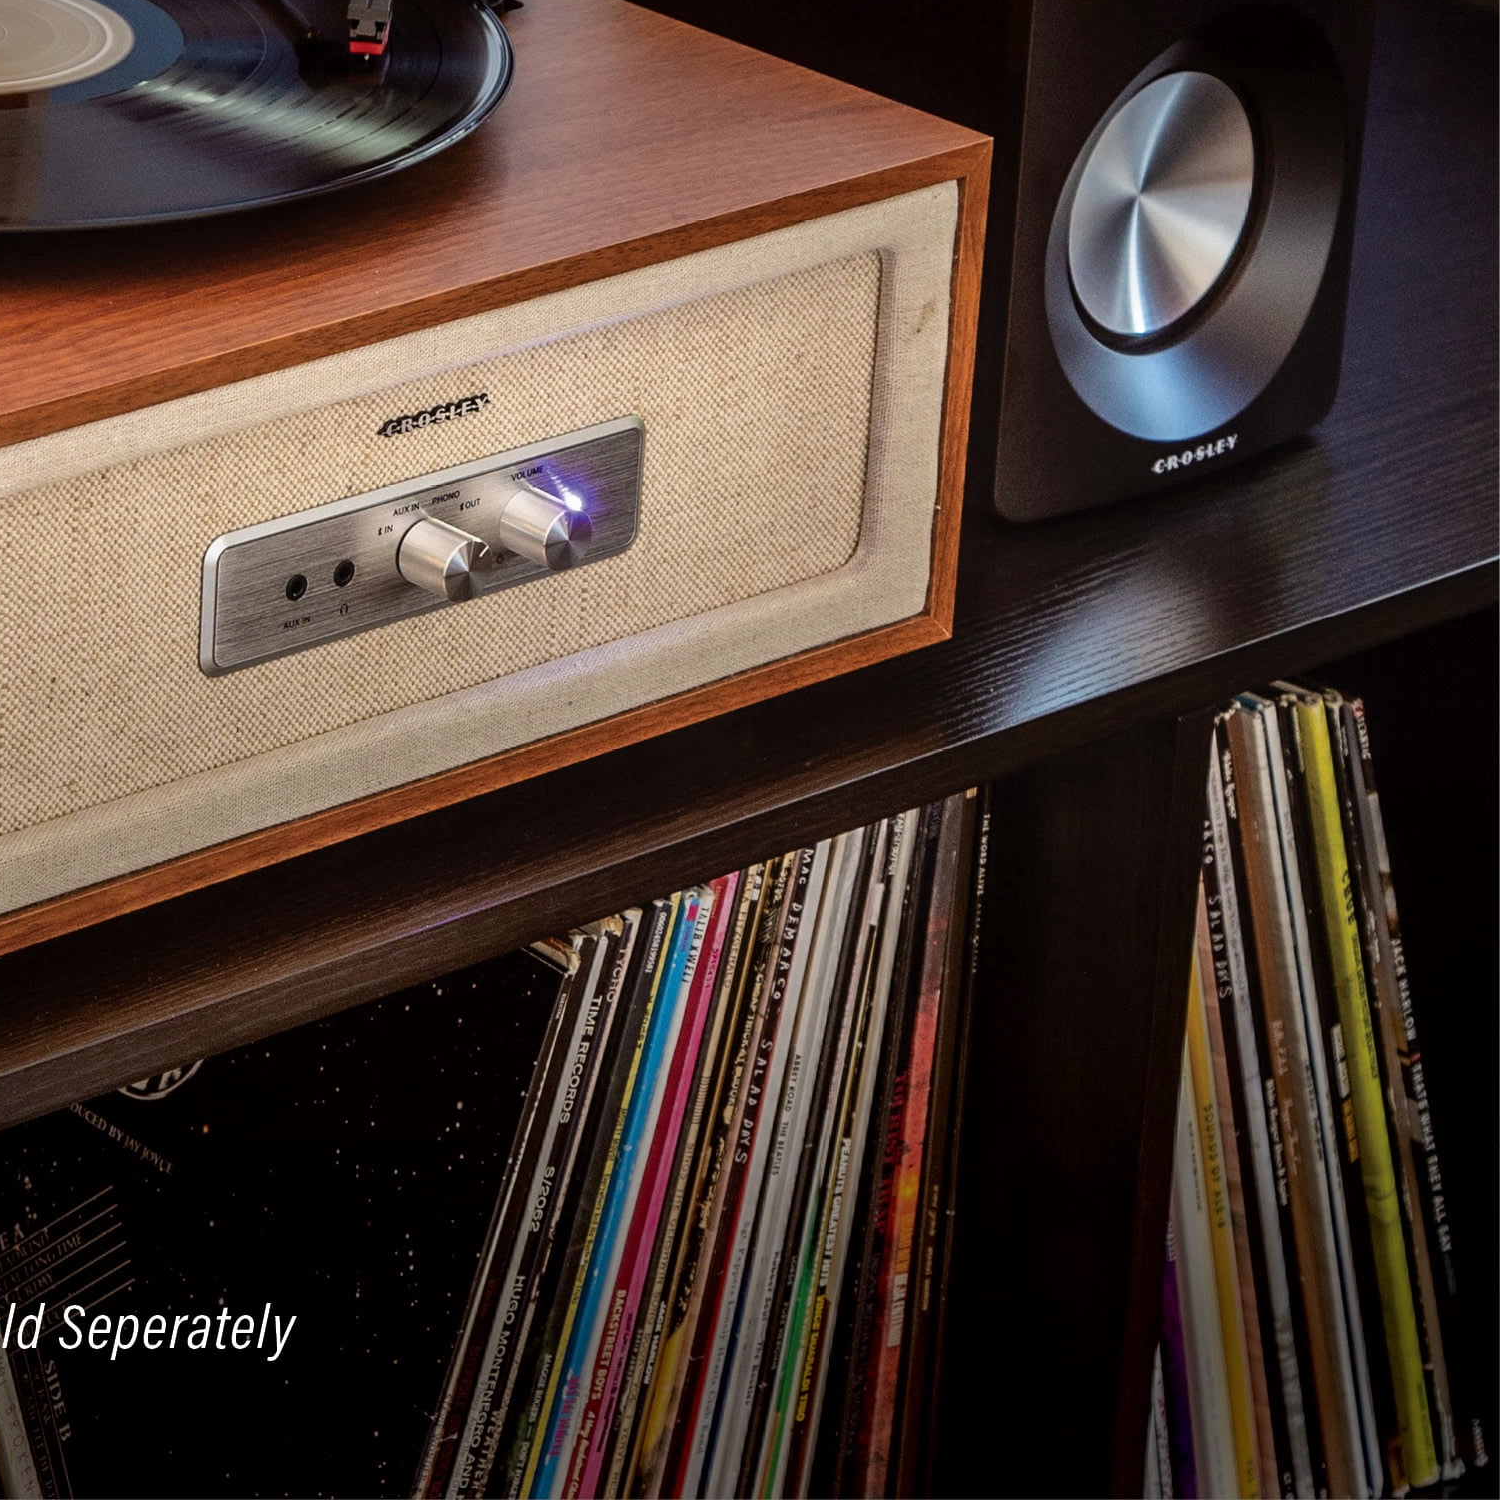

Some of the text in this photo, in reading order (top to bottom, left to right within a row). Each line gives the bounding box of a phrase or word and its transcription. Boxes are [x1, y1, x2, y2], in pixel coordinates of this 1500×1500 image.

[379, 394, 489, 437] CROSLEY
[511, 465, 545, 482] VOLUME
[1151, 433, 1238, 474] CROSLEY
[393, 502, 421, 517] AUX IN
[432, 490, 460, 506] PHONO
[464, 497, 481, 510] OUT
[384, 524, 393, 534] IN
[283, 616, 311, 630] AUX IN
[605, 948, 626, 1003] TYCHO
[681, 944, 699, 984] KWELI
[771, 902, 802, 1000] DEMARCO
[1391, 937, 1417, 1042] JACK HARLOW
[582, 994, 601, 1037] TIME
[558, 1041, 589, 1124] RECORDS
[734, 1038, 773, 1164] SALAD DAYS
[107, 1126, 124, 1142] BY
[833, 1137, 851, 1194] PEANUTS
[529, 1165, 555, 1232] S/2062
[823, 1195, 841, 1255] GREATEST
[598, 1288, 627, 1368] BACKSTREET
[43, 1359, 74, 1442] SIDE B
[456, 1274, 526, 1490] HUGO MONTENEGRO AND
[589, 1368, 607, 1402] BOYS
[471, 1408, 502, 1492] WEATHER
